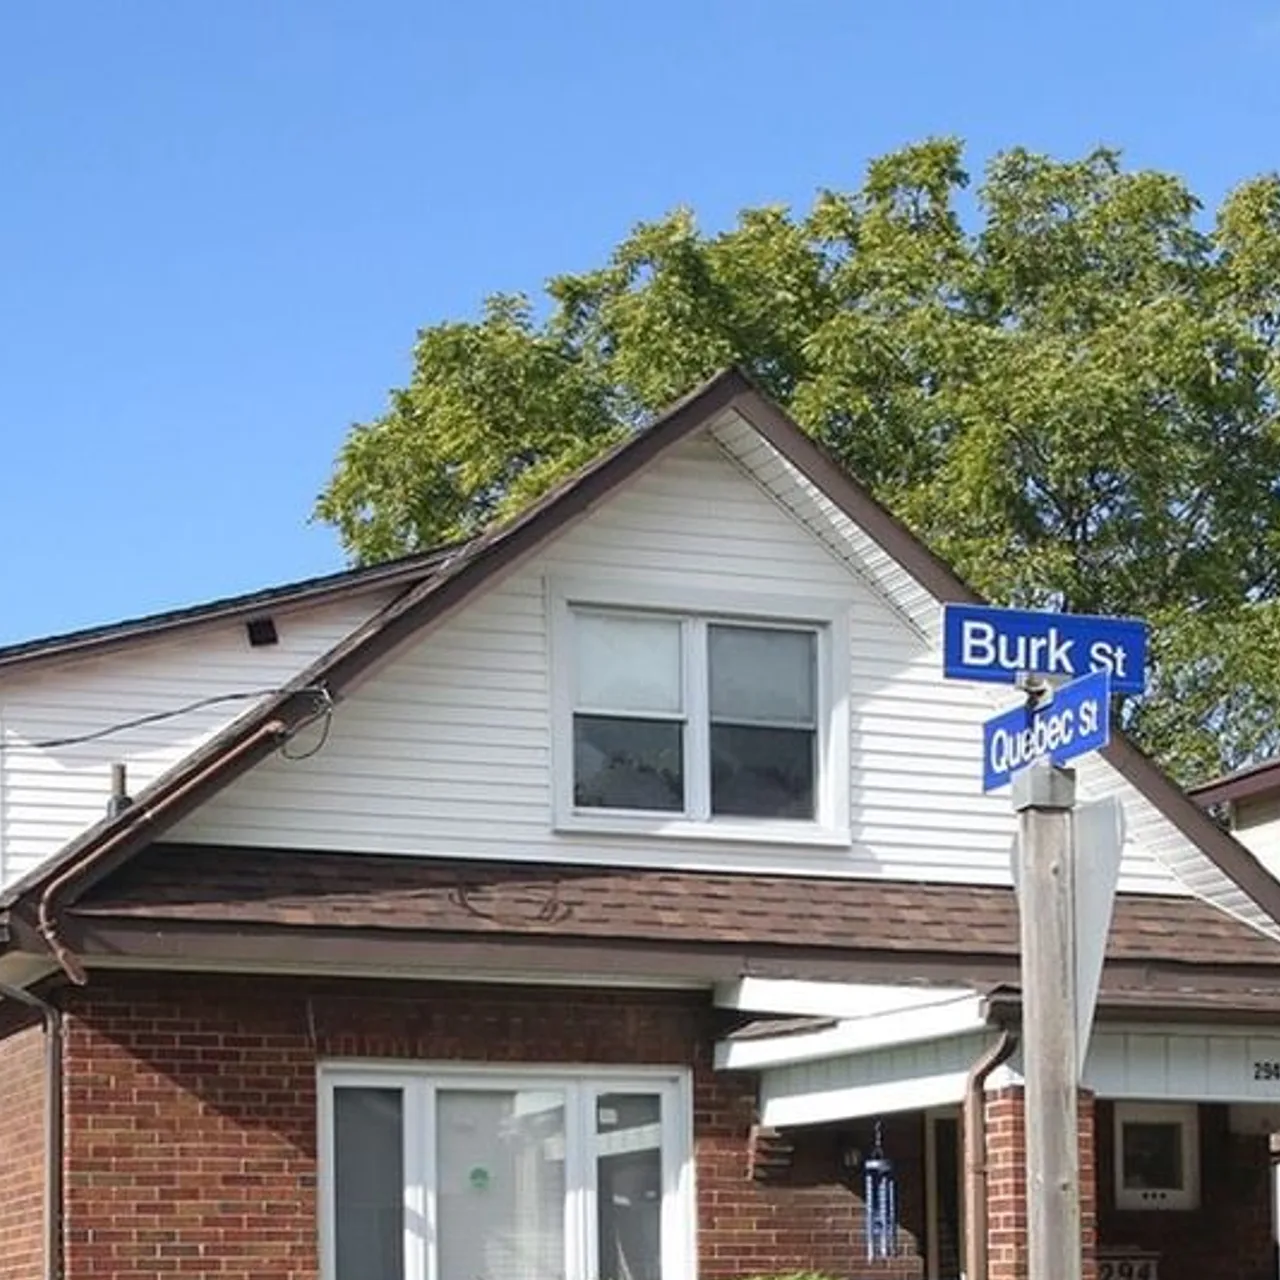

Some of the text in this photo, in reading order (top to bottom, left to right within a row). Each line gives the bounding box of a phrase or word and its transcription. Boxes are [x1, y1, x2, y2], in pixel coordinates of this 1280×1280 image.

[962, 620, 1127, 678] Burk St
[990, 699, 1099, 773] Quebec St
